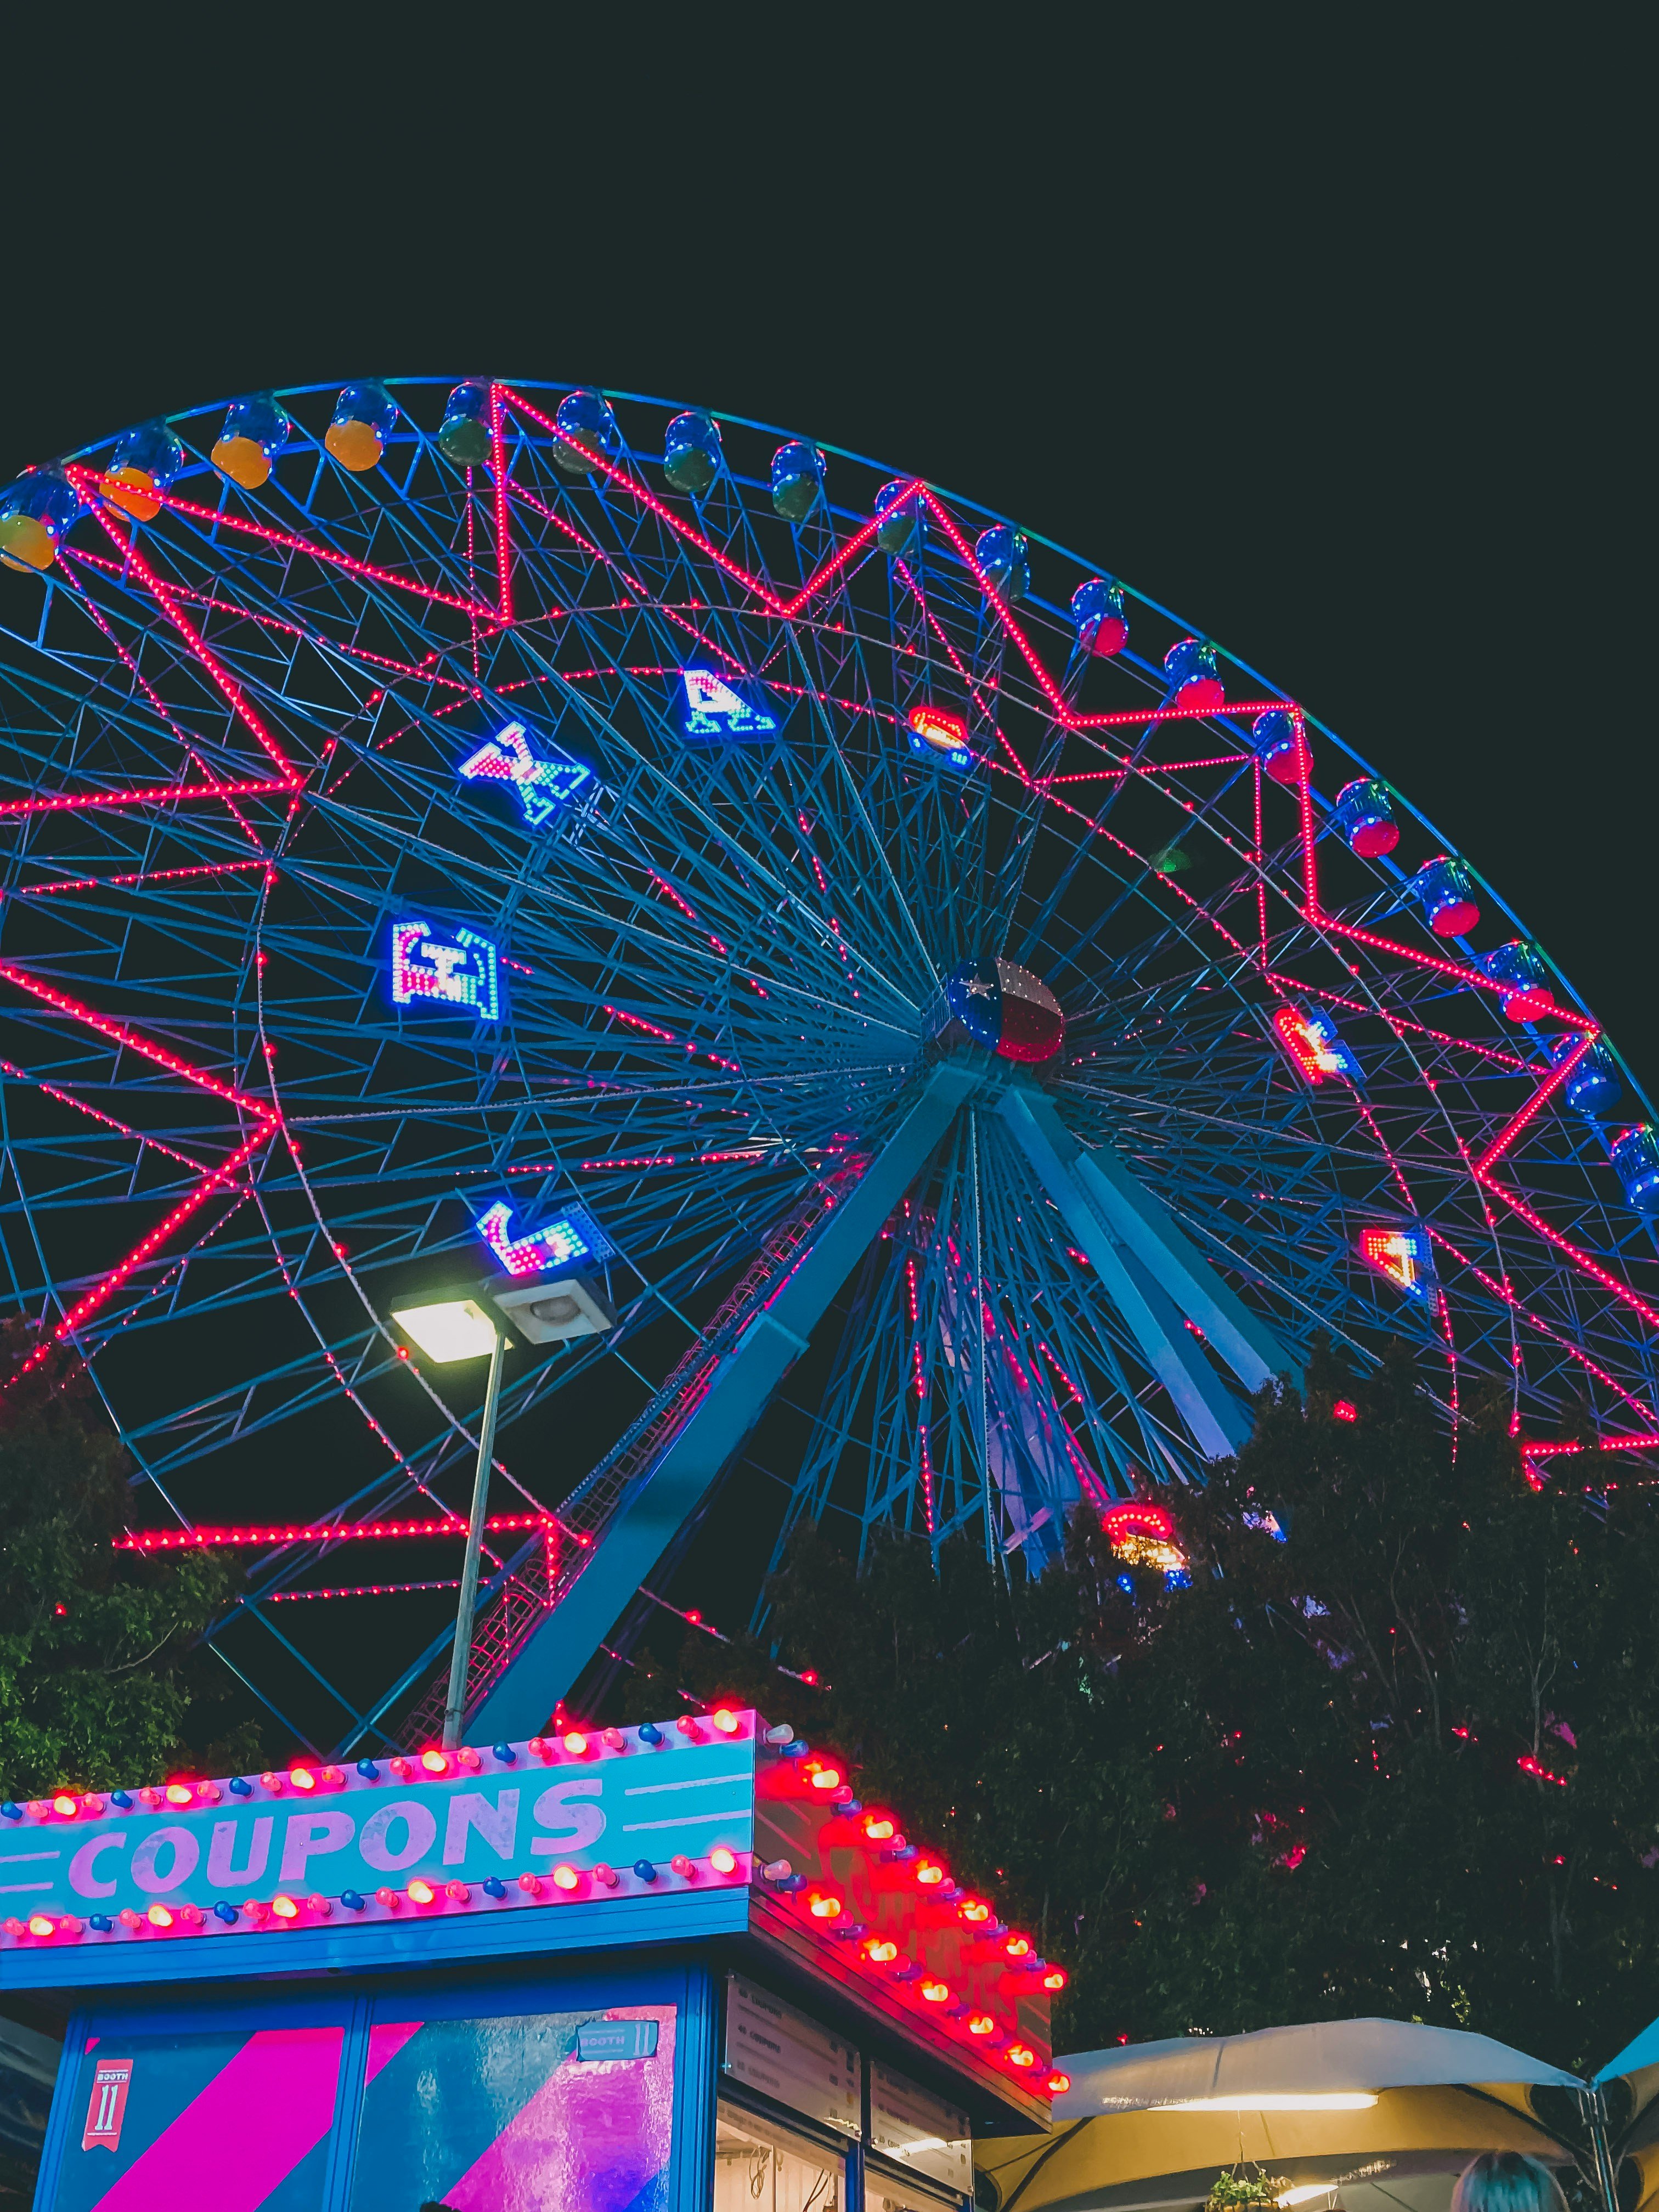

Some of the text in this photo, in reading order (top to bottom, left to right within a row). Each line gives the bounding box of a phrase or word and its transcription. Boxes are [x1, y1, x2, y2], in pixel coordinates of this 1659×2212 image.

[69, 1778, 607, 1898] COUPONS
[580, 2023, 650, 2056] BOOTH 11
[97, 2073, 128, 2081] BOOTH
[94, 2084, 119, 2130] 11
